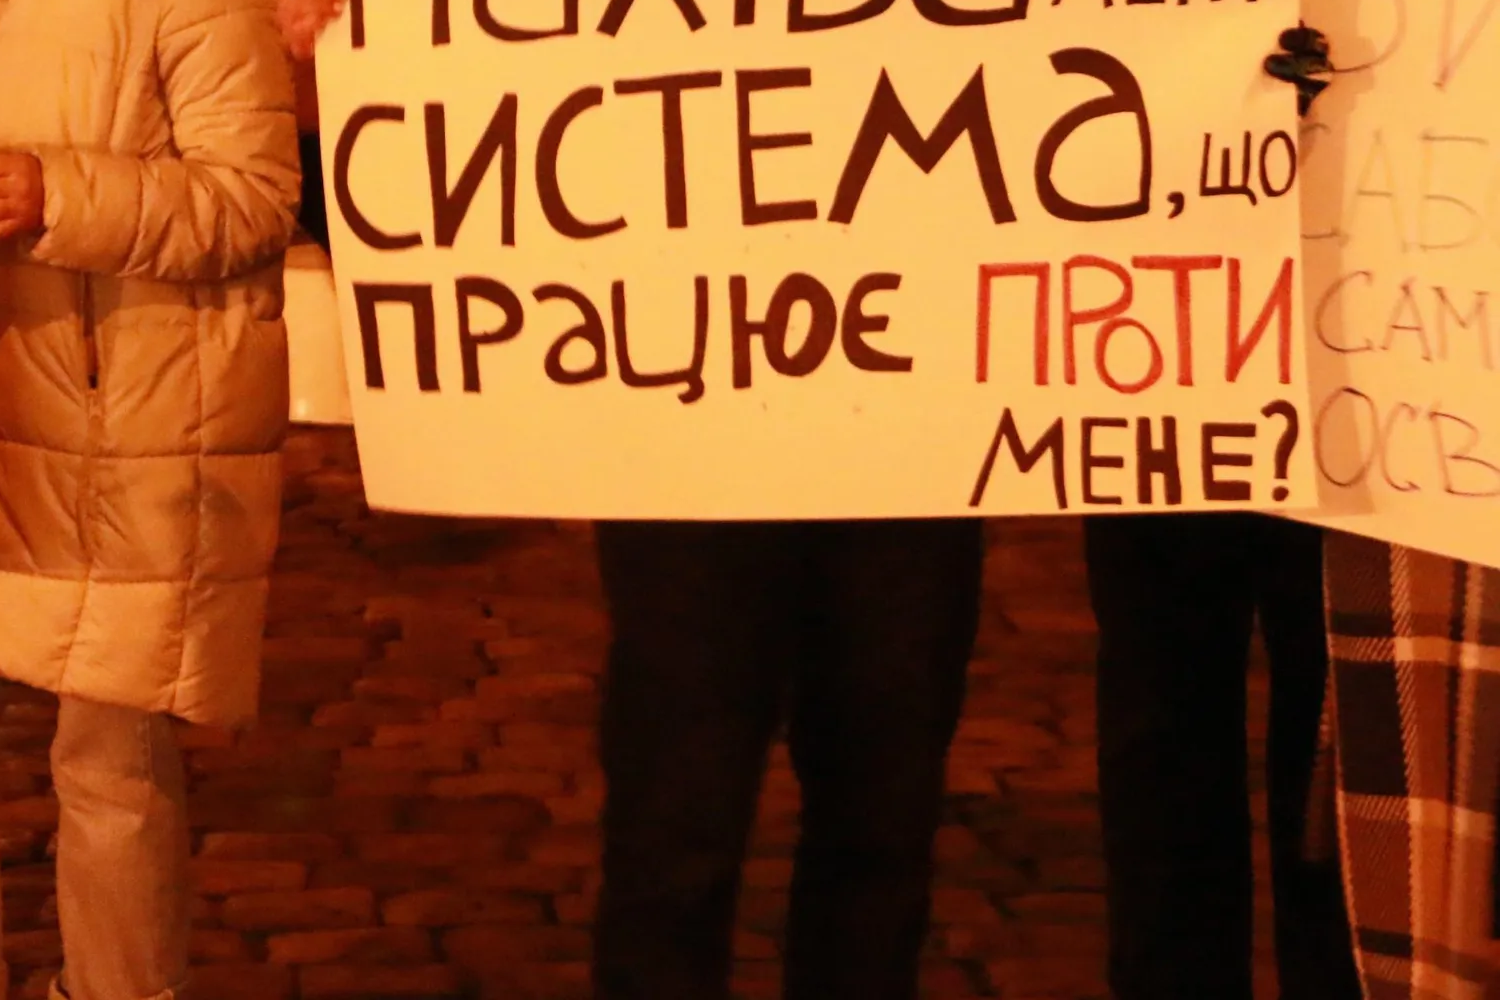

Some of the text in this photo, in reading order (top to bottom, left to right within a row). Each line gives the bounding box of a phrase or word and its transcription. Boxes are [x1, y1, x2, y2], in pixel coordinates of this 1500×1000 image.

[1200, 129, 1297, 206] ЩО
[975, 254, 1294, 394] ПРОТИ
[968, 399, 1300, 510] МЕНЕ?
